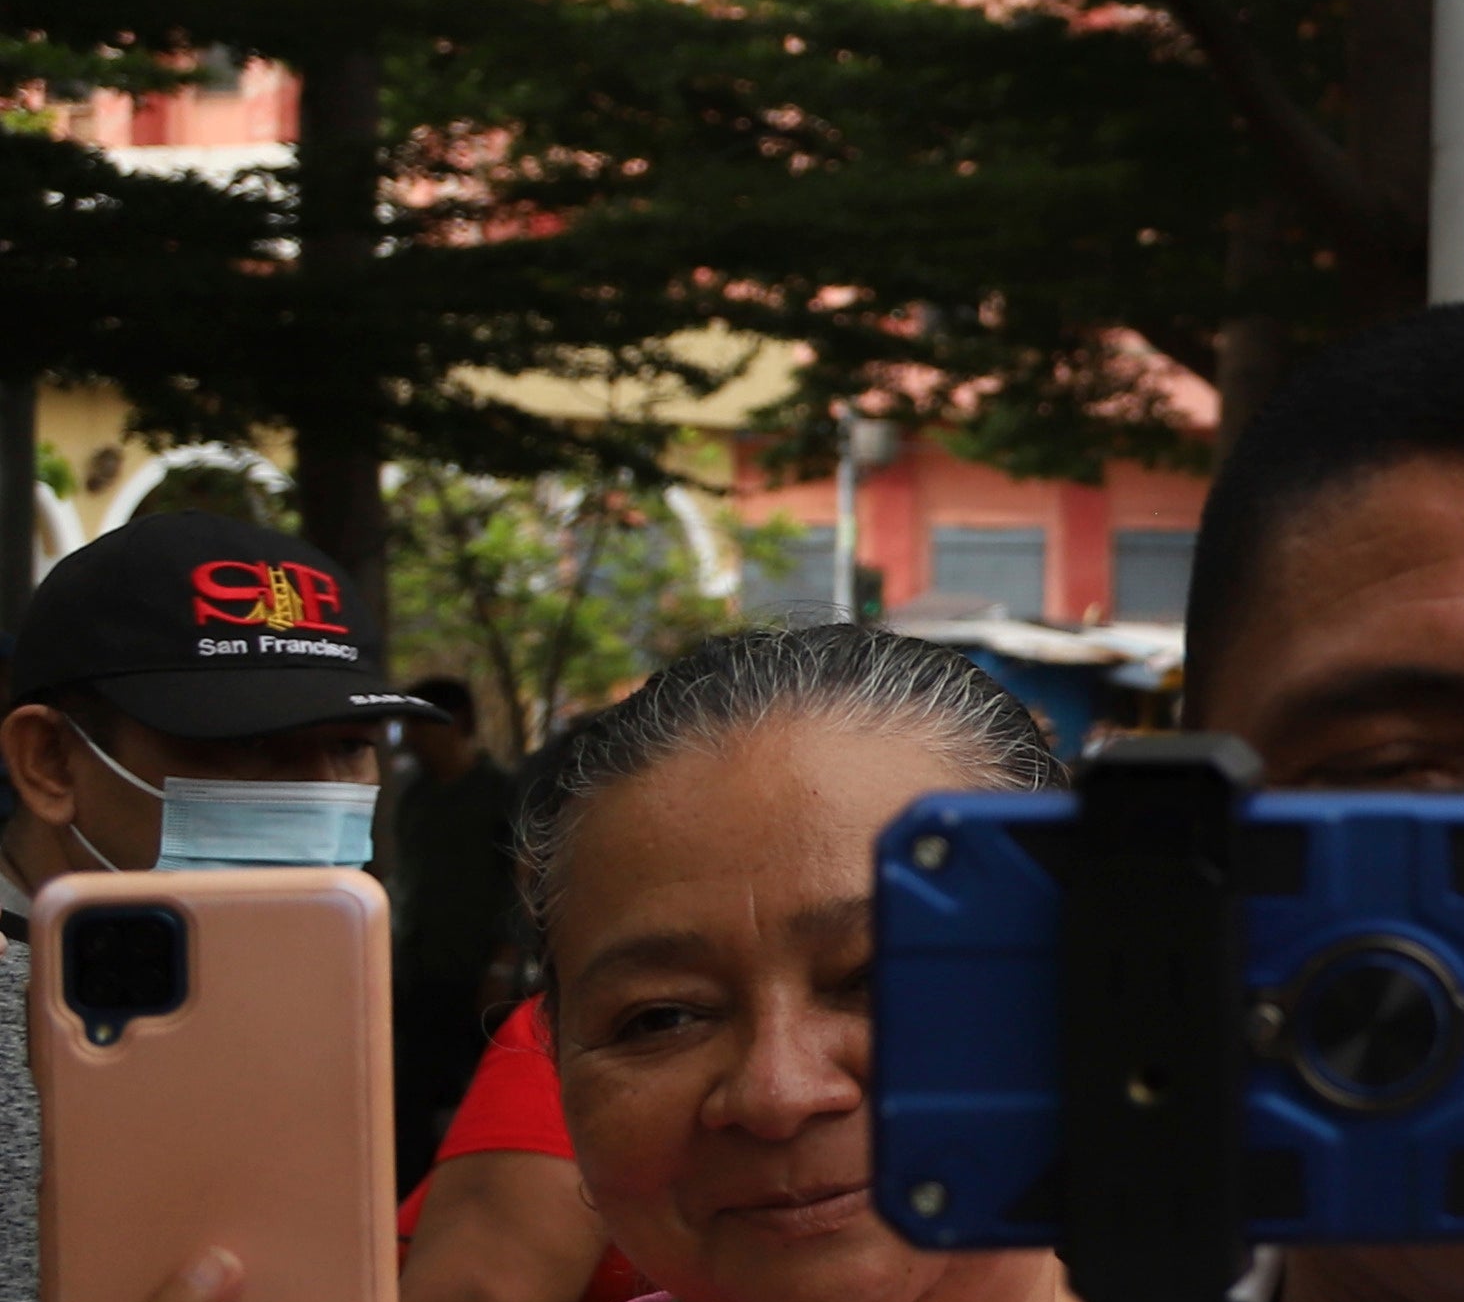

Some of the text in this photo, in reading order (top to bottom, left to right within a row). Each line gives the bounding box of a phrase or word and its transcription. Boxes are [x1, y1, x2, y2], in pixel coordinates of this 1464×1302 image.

[191, 560, 349, 635] SF
[198, 635, 359, 661] San Francisco
